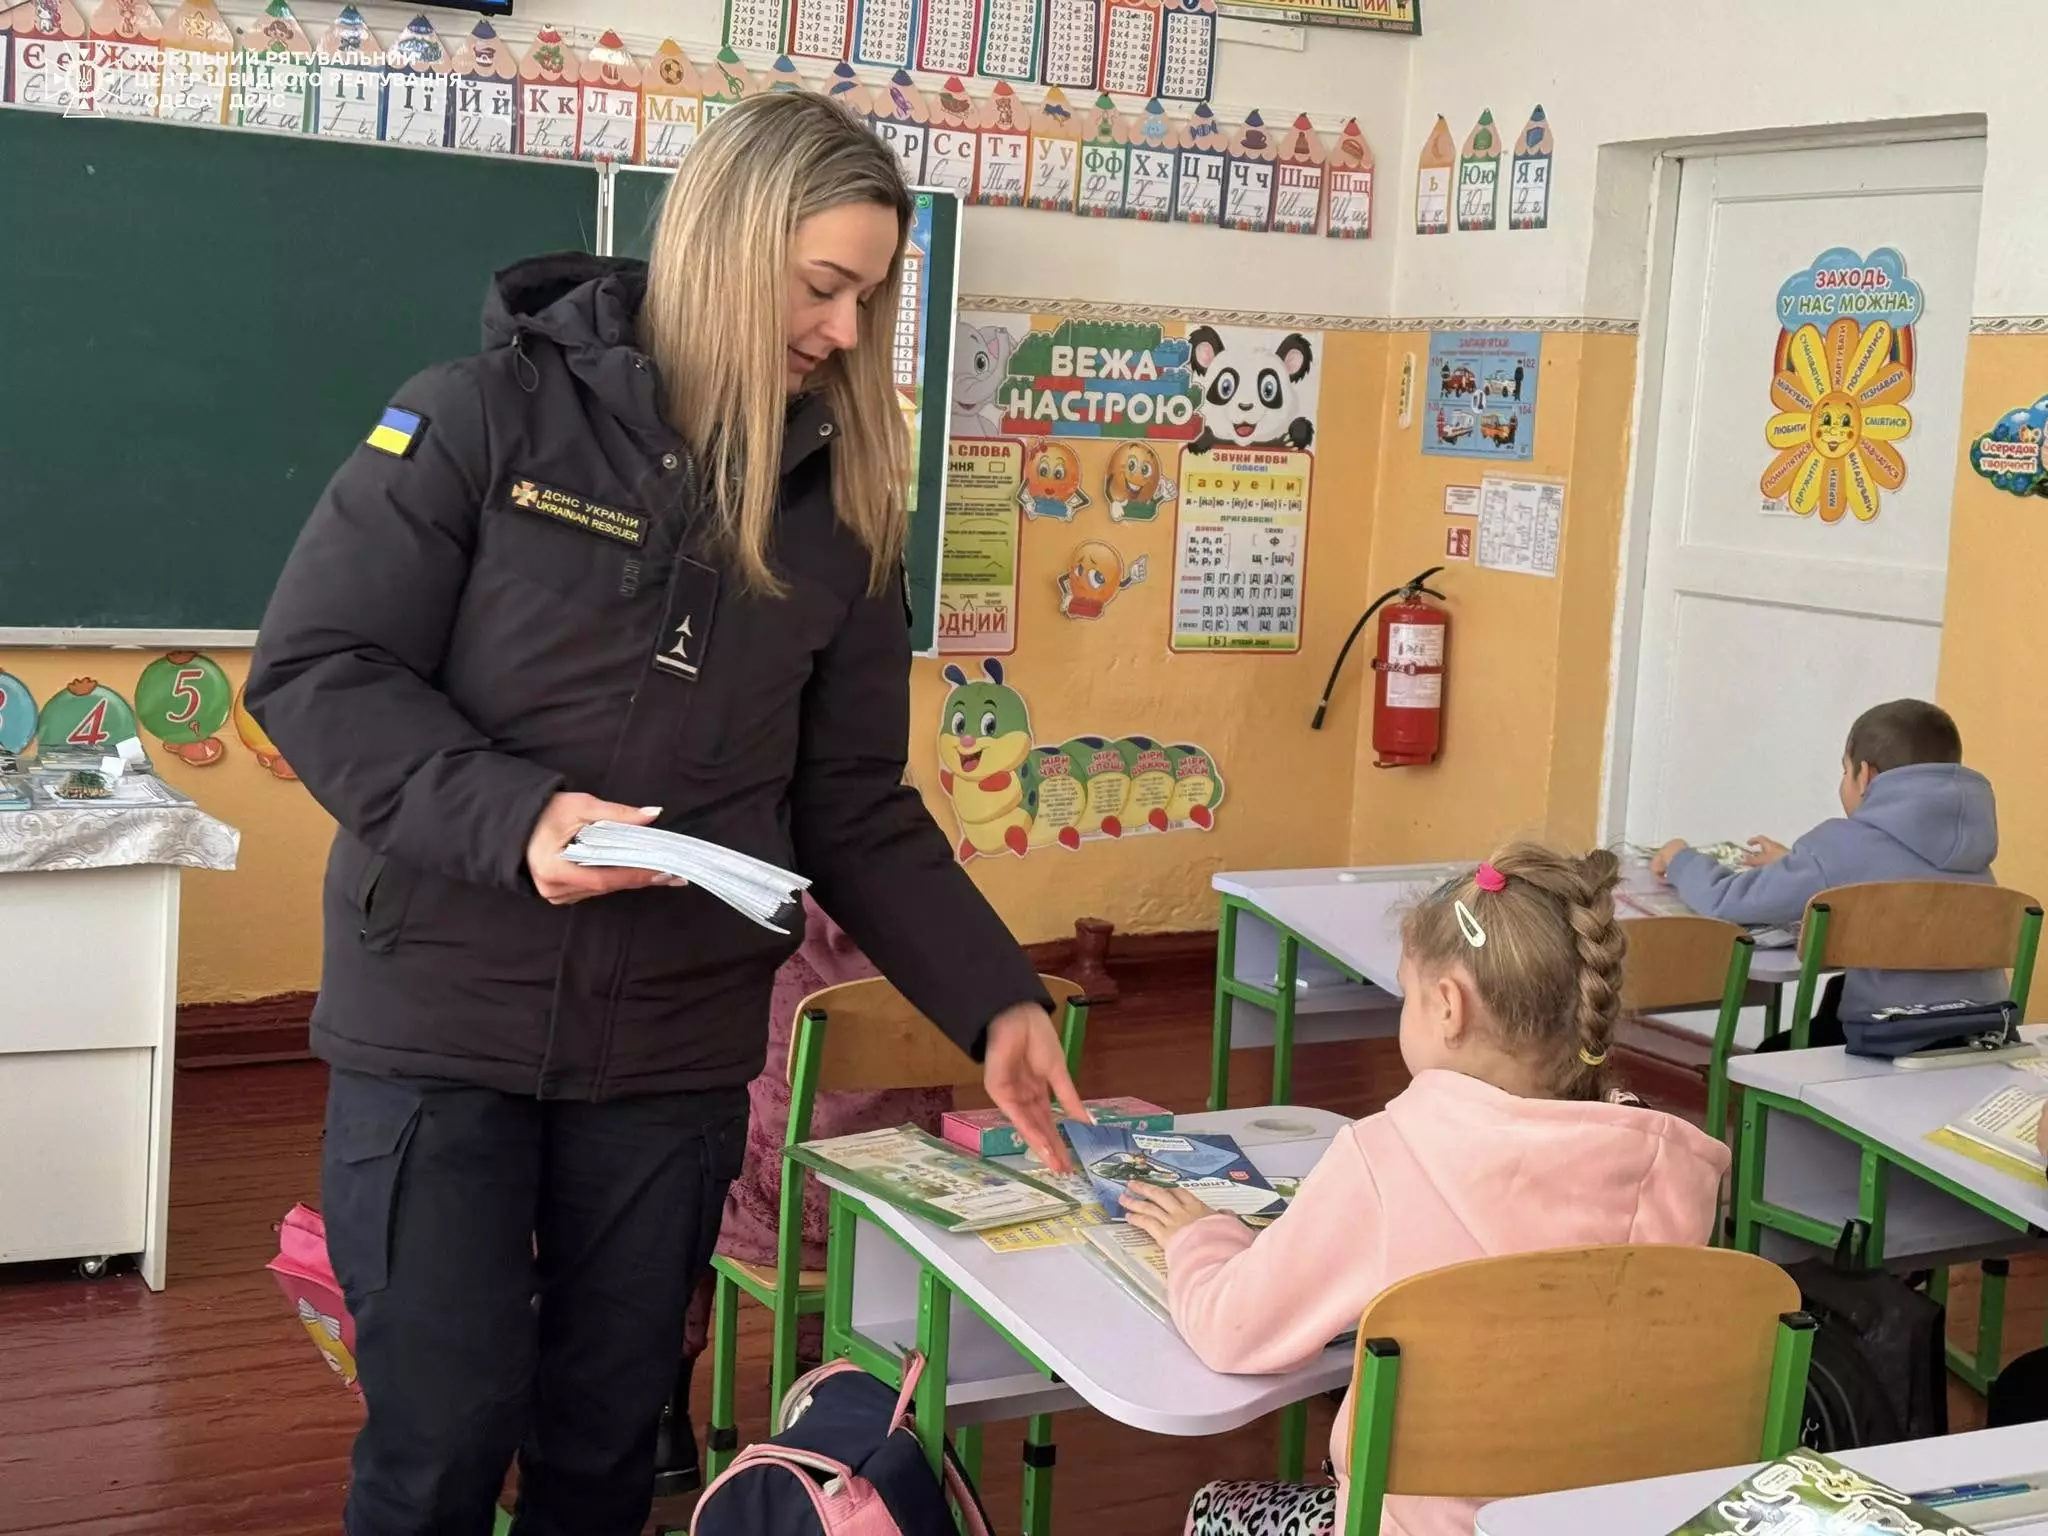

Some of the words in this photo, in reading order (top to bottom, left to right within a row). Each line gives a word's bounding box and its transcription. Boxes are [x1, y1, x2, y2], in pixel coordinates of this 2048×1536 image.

[1815, 268, 1891, 291] ЗАХОДЬ,
[1783, 296, 1795, 314] У
[1800, 296, 1835, 313] НАС
[1840, 292, 1914, 312] МОЖНА:
[1051, 345, 1159, 380] ВЕЖА
[1010, 388, 1192, 425] НАСТРОЮ
[958, 444, 1011, 458] СЛОВА
[1212, 452, 1251, 464] ЗВУКИ
[1254, 454, 1288, 465] МОВИ
[1982, 443, 2036, 455] Осередок
[535, 501, 590, 525] UKRAINIAN
[591, 519, 640, 542] RESCUER
[541, 489, 580, 508] ДСНС
[585, 503, 639, 528] УКРАЇНИ
[166, 669, 206, 723] 5
[67, 699, 109, 745] 4
